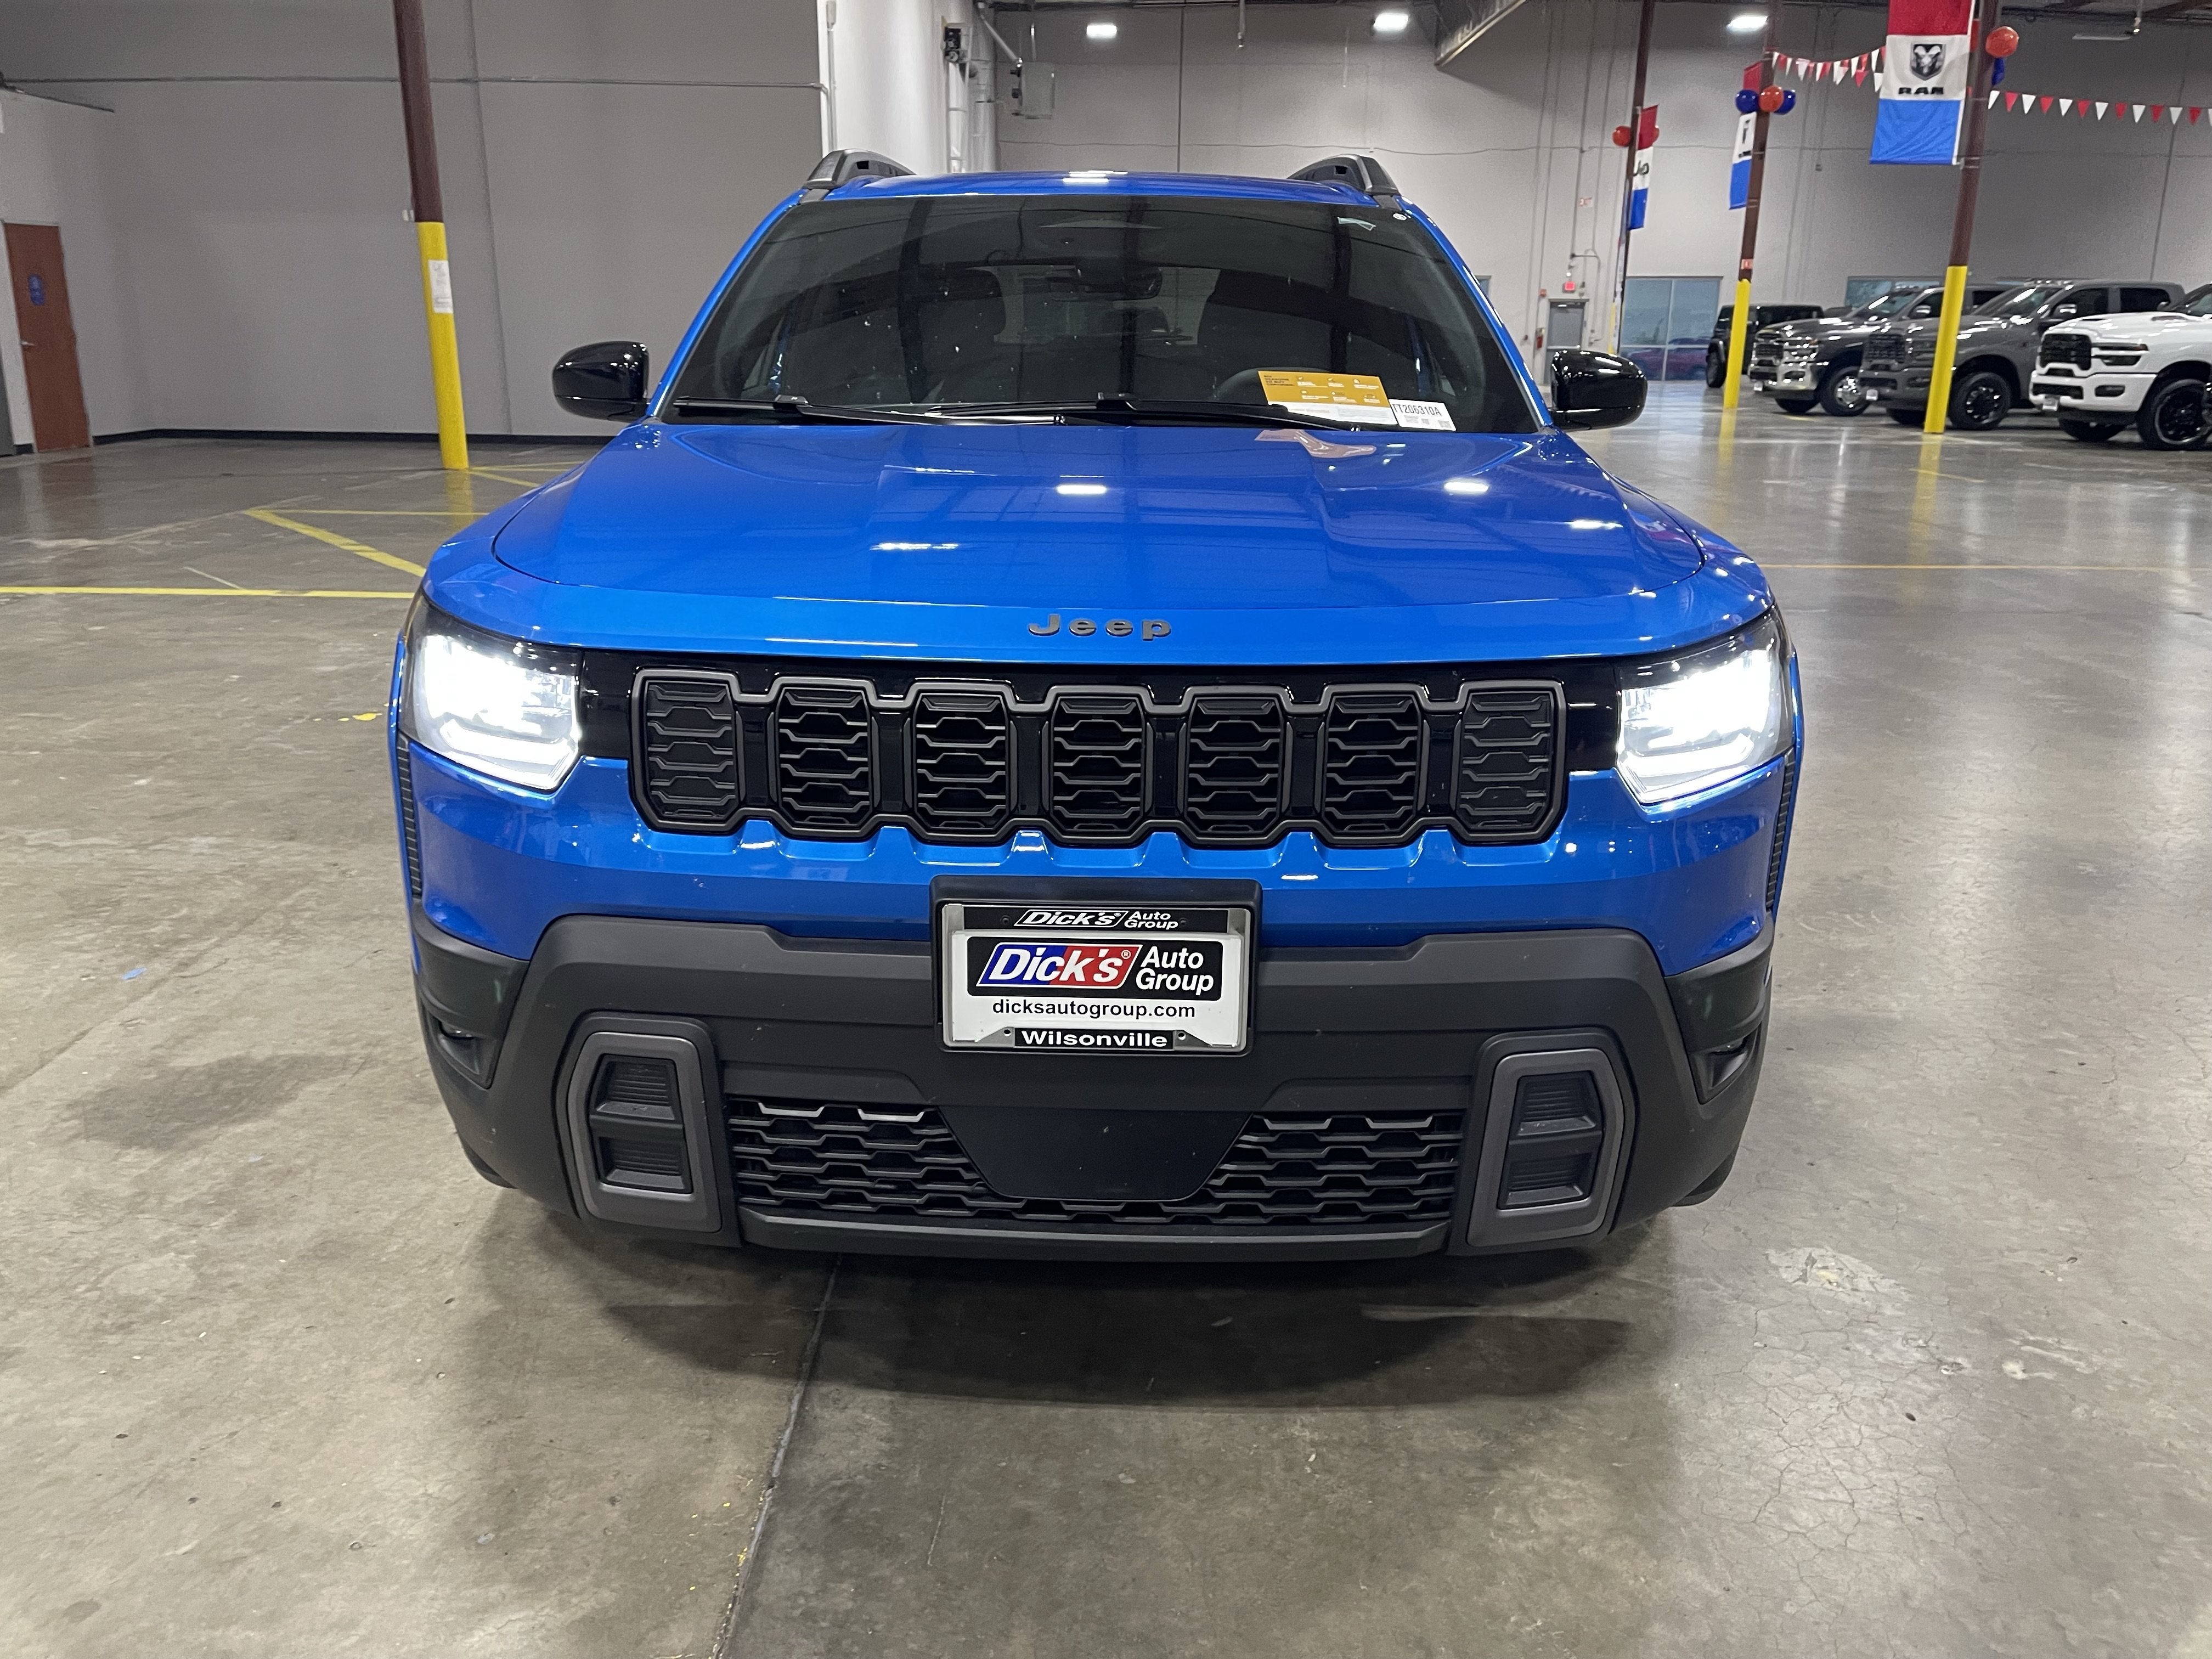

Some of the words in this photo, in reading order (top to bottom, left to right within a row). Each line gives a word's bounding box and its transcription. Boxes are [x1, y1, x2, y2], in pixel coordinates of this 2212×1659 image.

[1898, 87, 1944, 95] RAM
[1028, 614, 1172, 641] Jeep
[1124, 919, 1179, 930] Group
[1128, 911, 1171, 920] Auto
[1141, 946, 1204, 969] Auto
[1136, 968, 1214, 996] Group
[992, 999, 1195, 1019] dicksautogroup.com
[1021, 1030, 1167, 1047] Wilsonville
